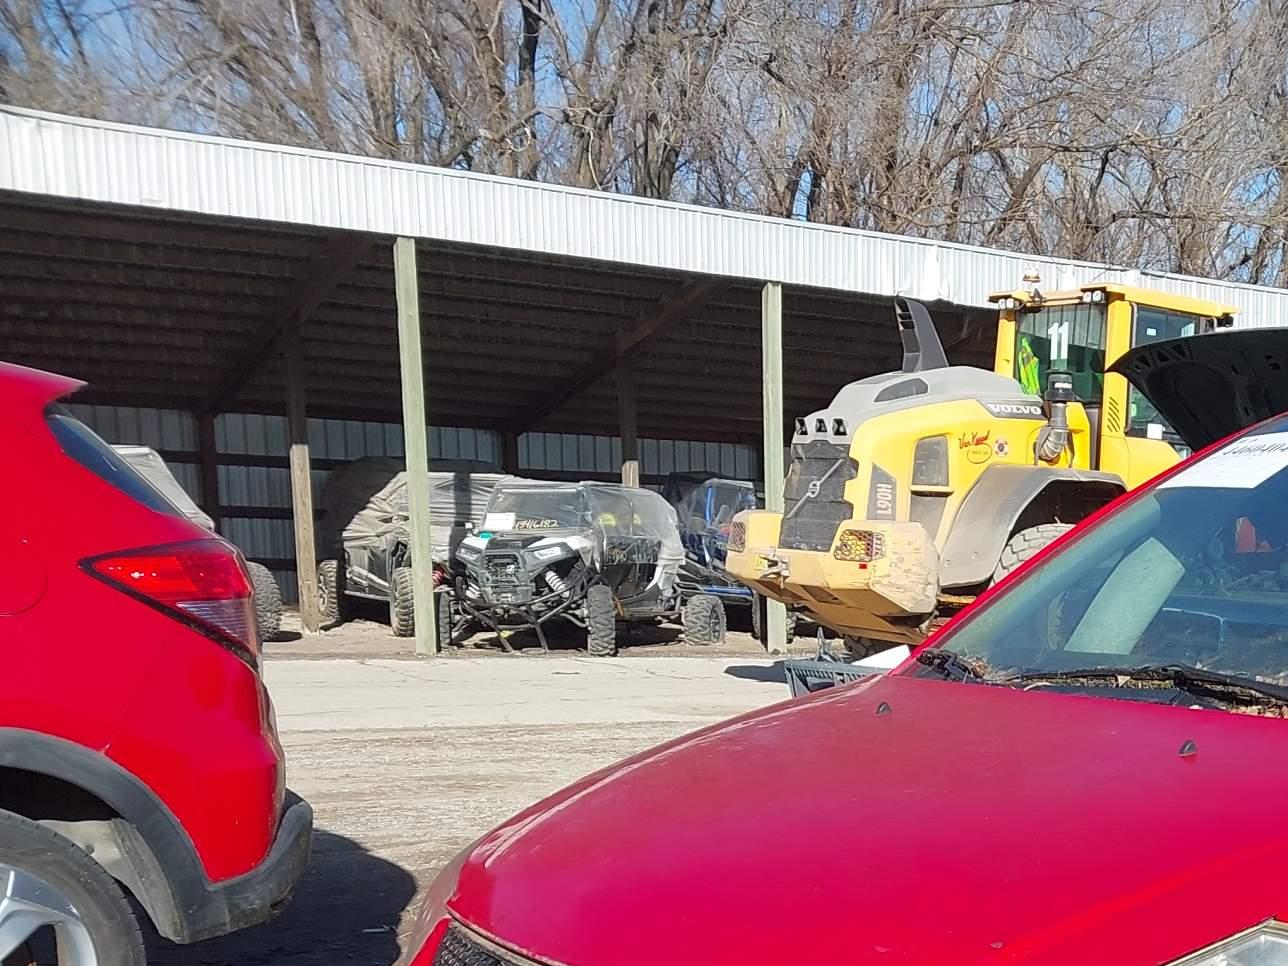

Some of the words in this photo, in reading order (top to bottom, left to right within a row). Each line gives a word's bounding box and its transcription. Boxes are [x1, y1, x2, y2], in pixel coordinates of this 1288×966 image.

[1048, 322, 1069, 360] 11
[986, 403, 1041, 415] VOLVO
[876, 483, 892, 515] L90H
